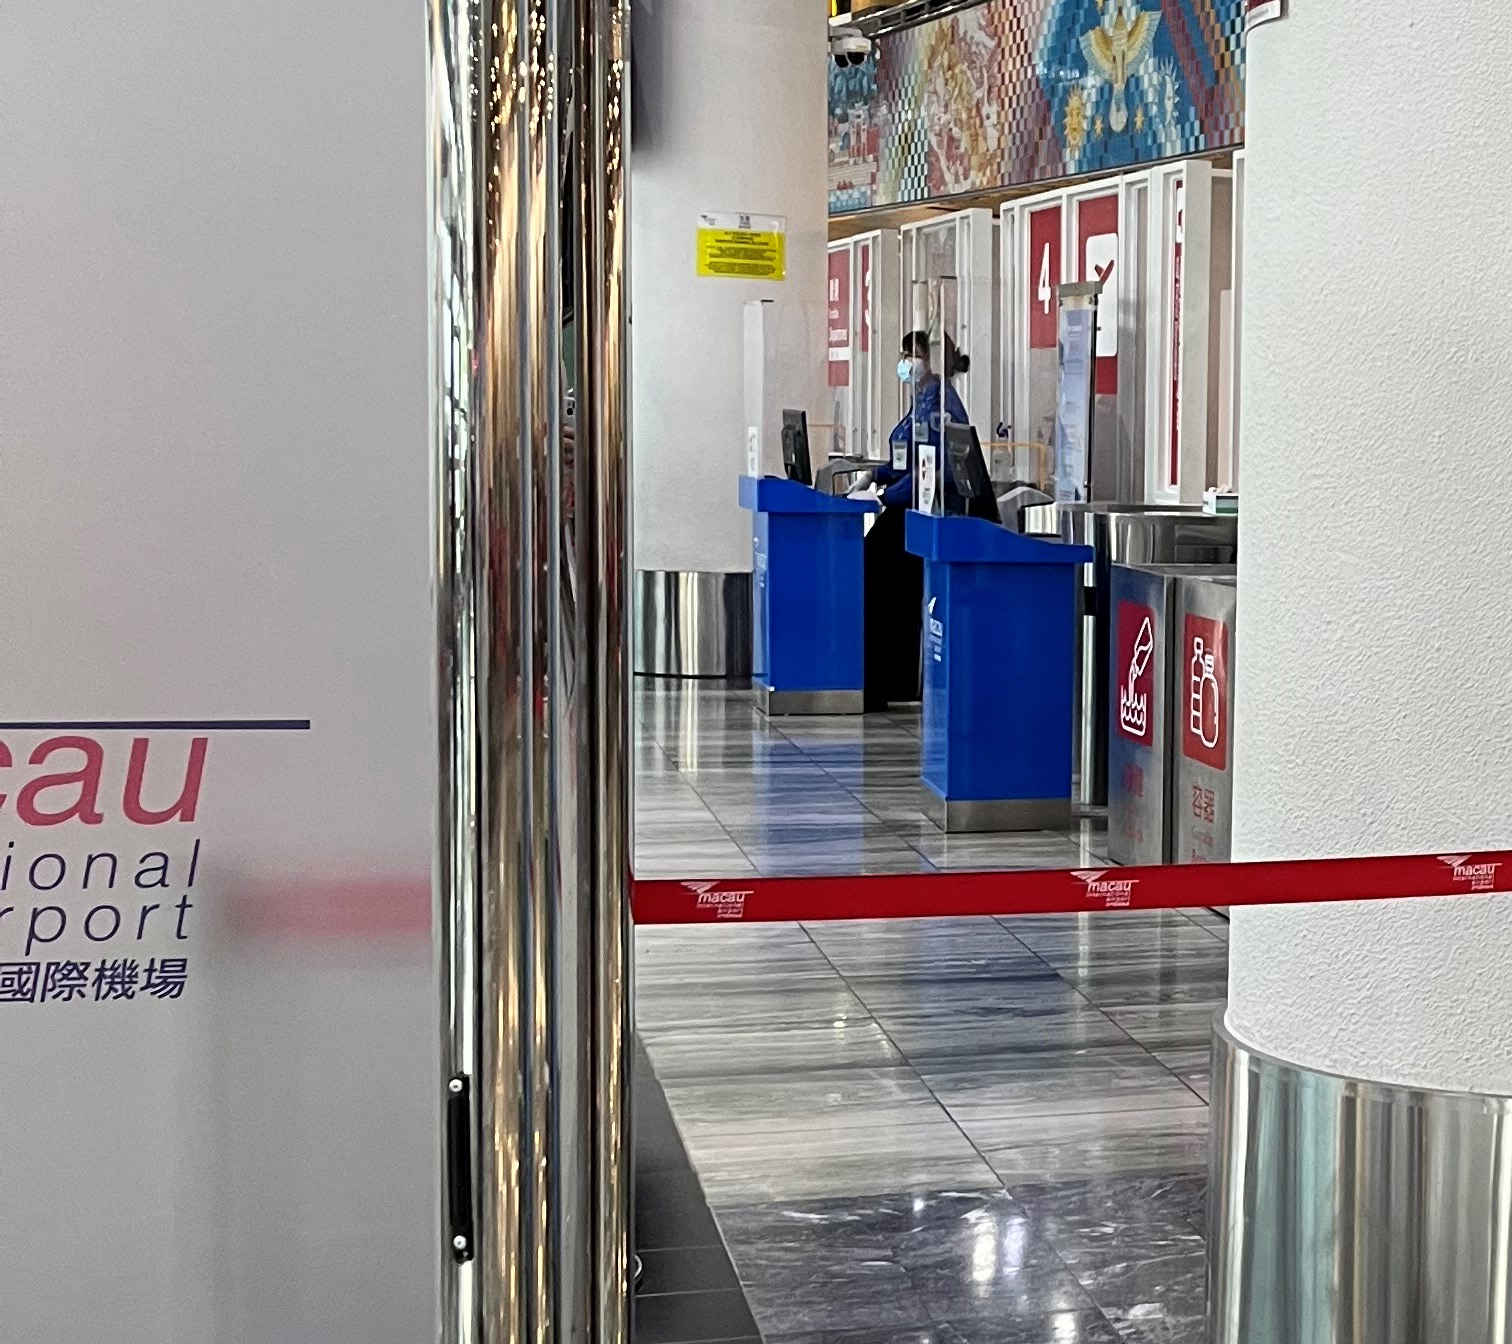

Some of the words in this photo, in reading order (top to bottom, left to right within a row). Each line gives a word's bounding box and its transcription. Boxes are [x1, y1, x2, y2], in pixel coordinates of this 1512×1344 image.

[1037, 242, 1052, 315] 4
[0, 735, 208, 826] au
[1454, 864, 1496, 876] macau
[698, 891, 745, 904] macau
[1087, 881, 1132, 893] macau
[0, 958, 188, 1003] 國際機場
